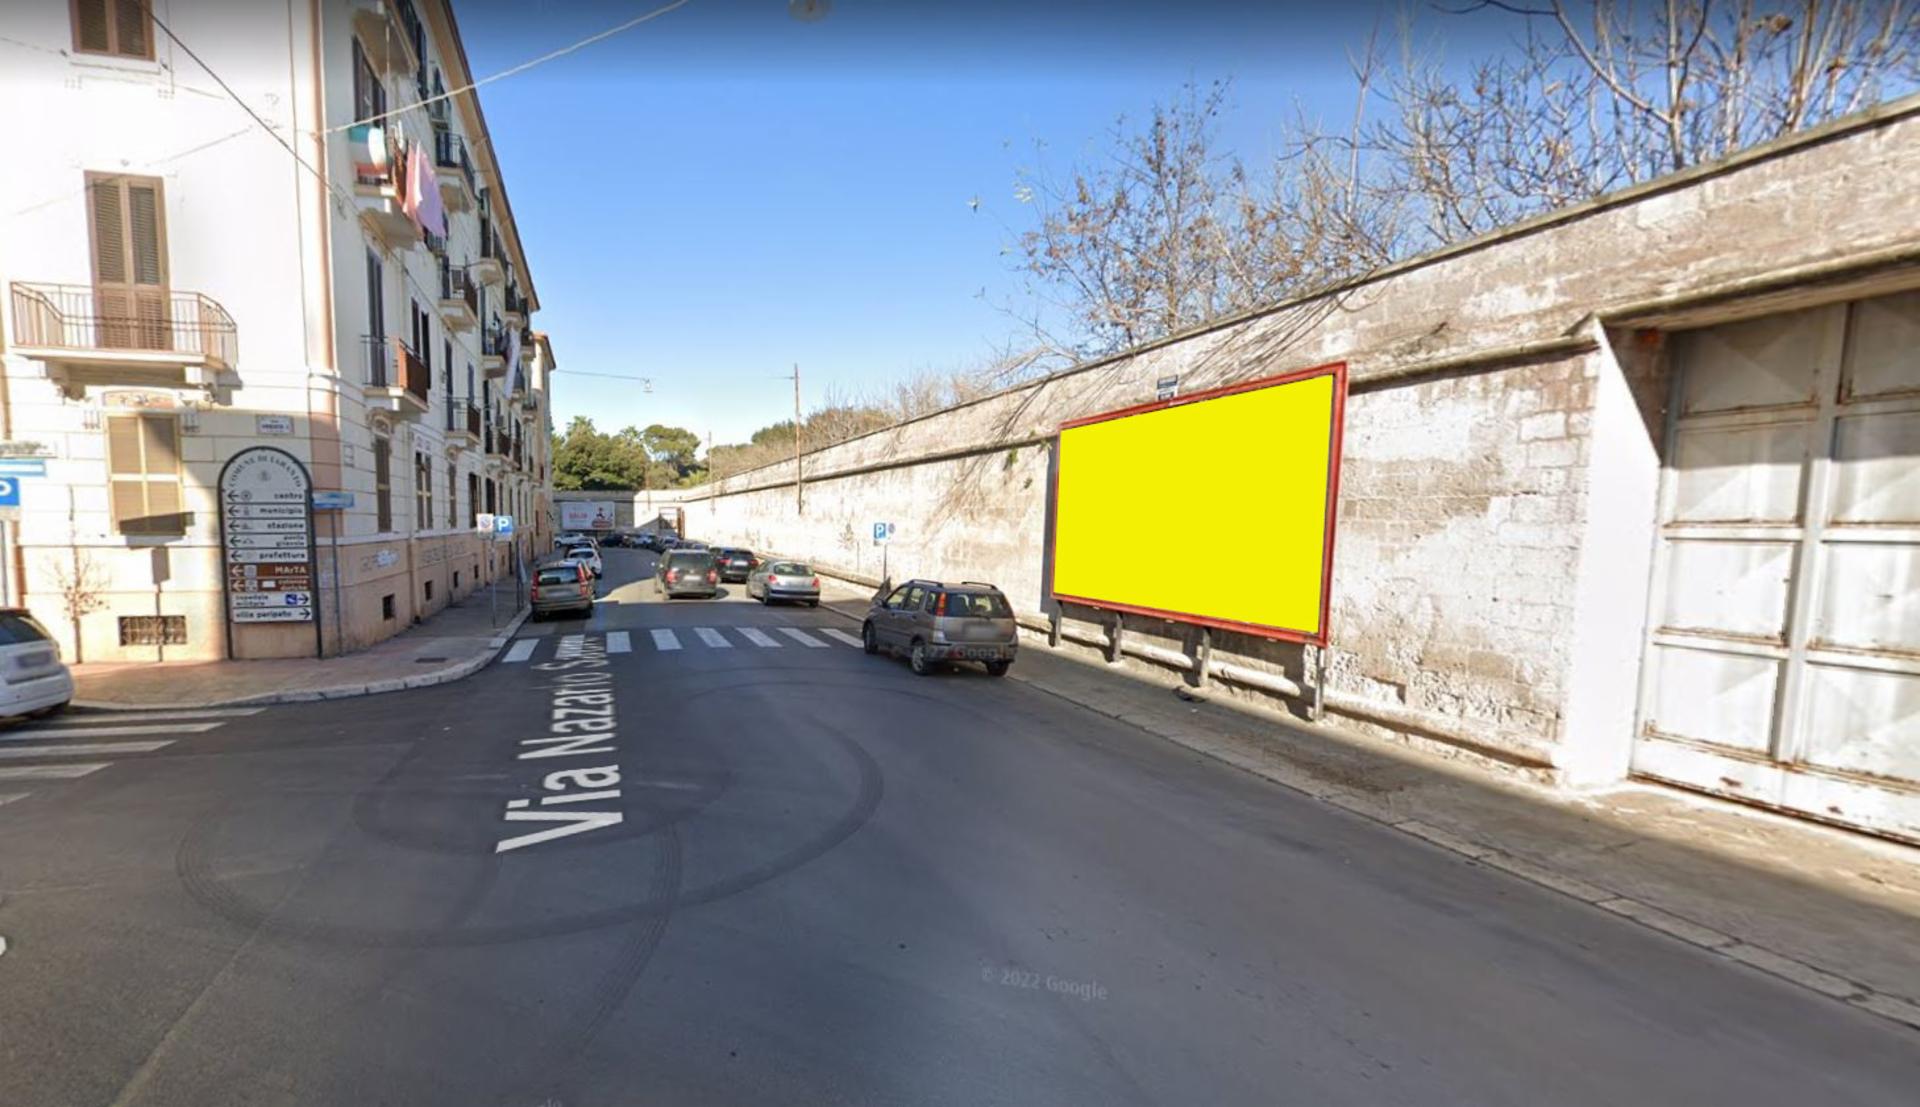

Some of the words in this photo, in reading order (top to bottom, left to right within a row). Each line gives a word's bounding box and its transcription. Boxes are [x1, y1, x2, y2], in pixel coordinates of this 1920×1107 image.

[274, 491, 303, 500] centro
[260, 507, 303, 515] municipio
[498, 518, 509, 531] P
[876, 524, 884, 538] P
[259, 551, 305, 560] prefettura
[274, 566, 306, 574] MArTA
